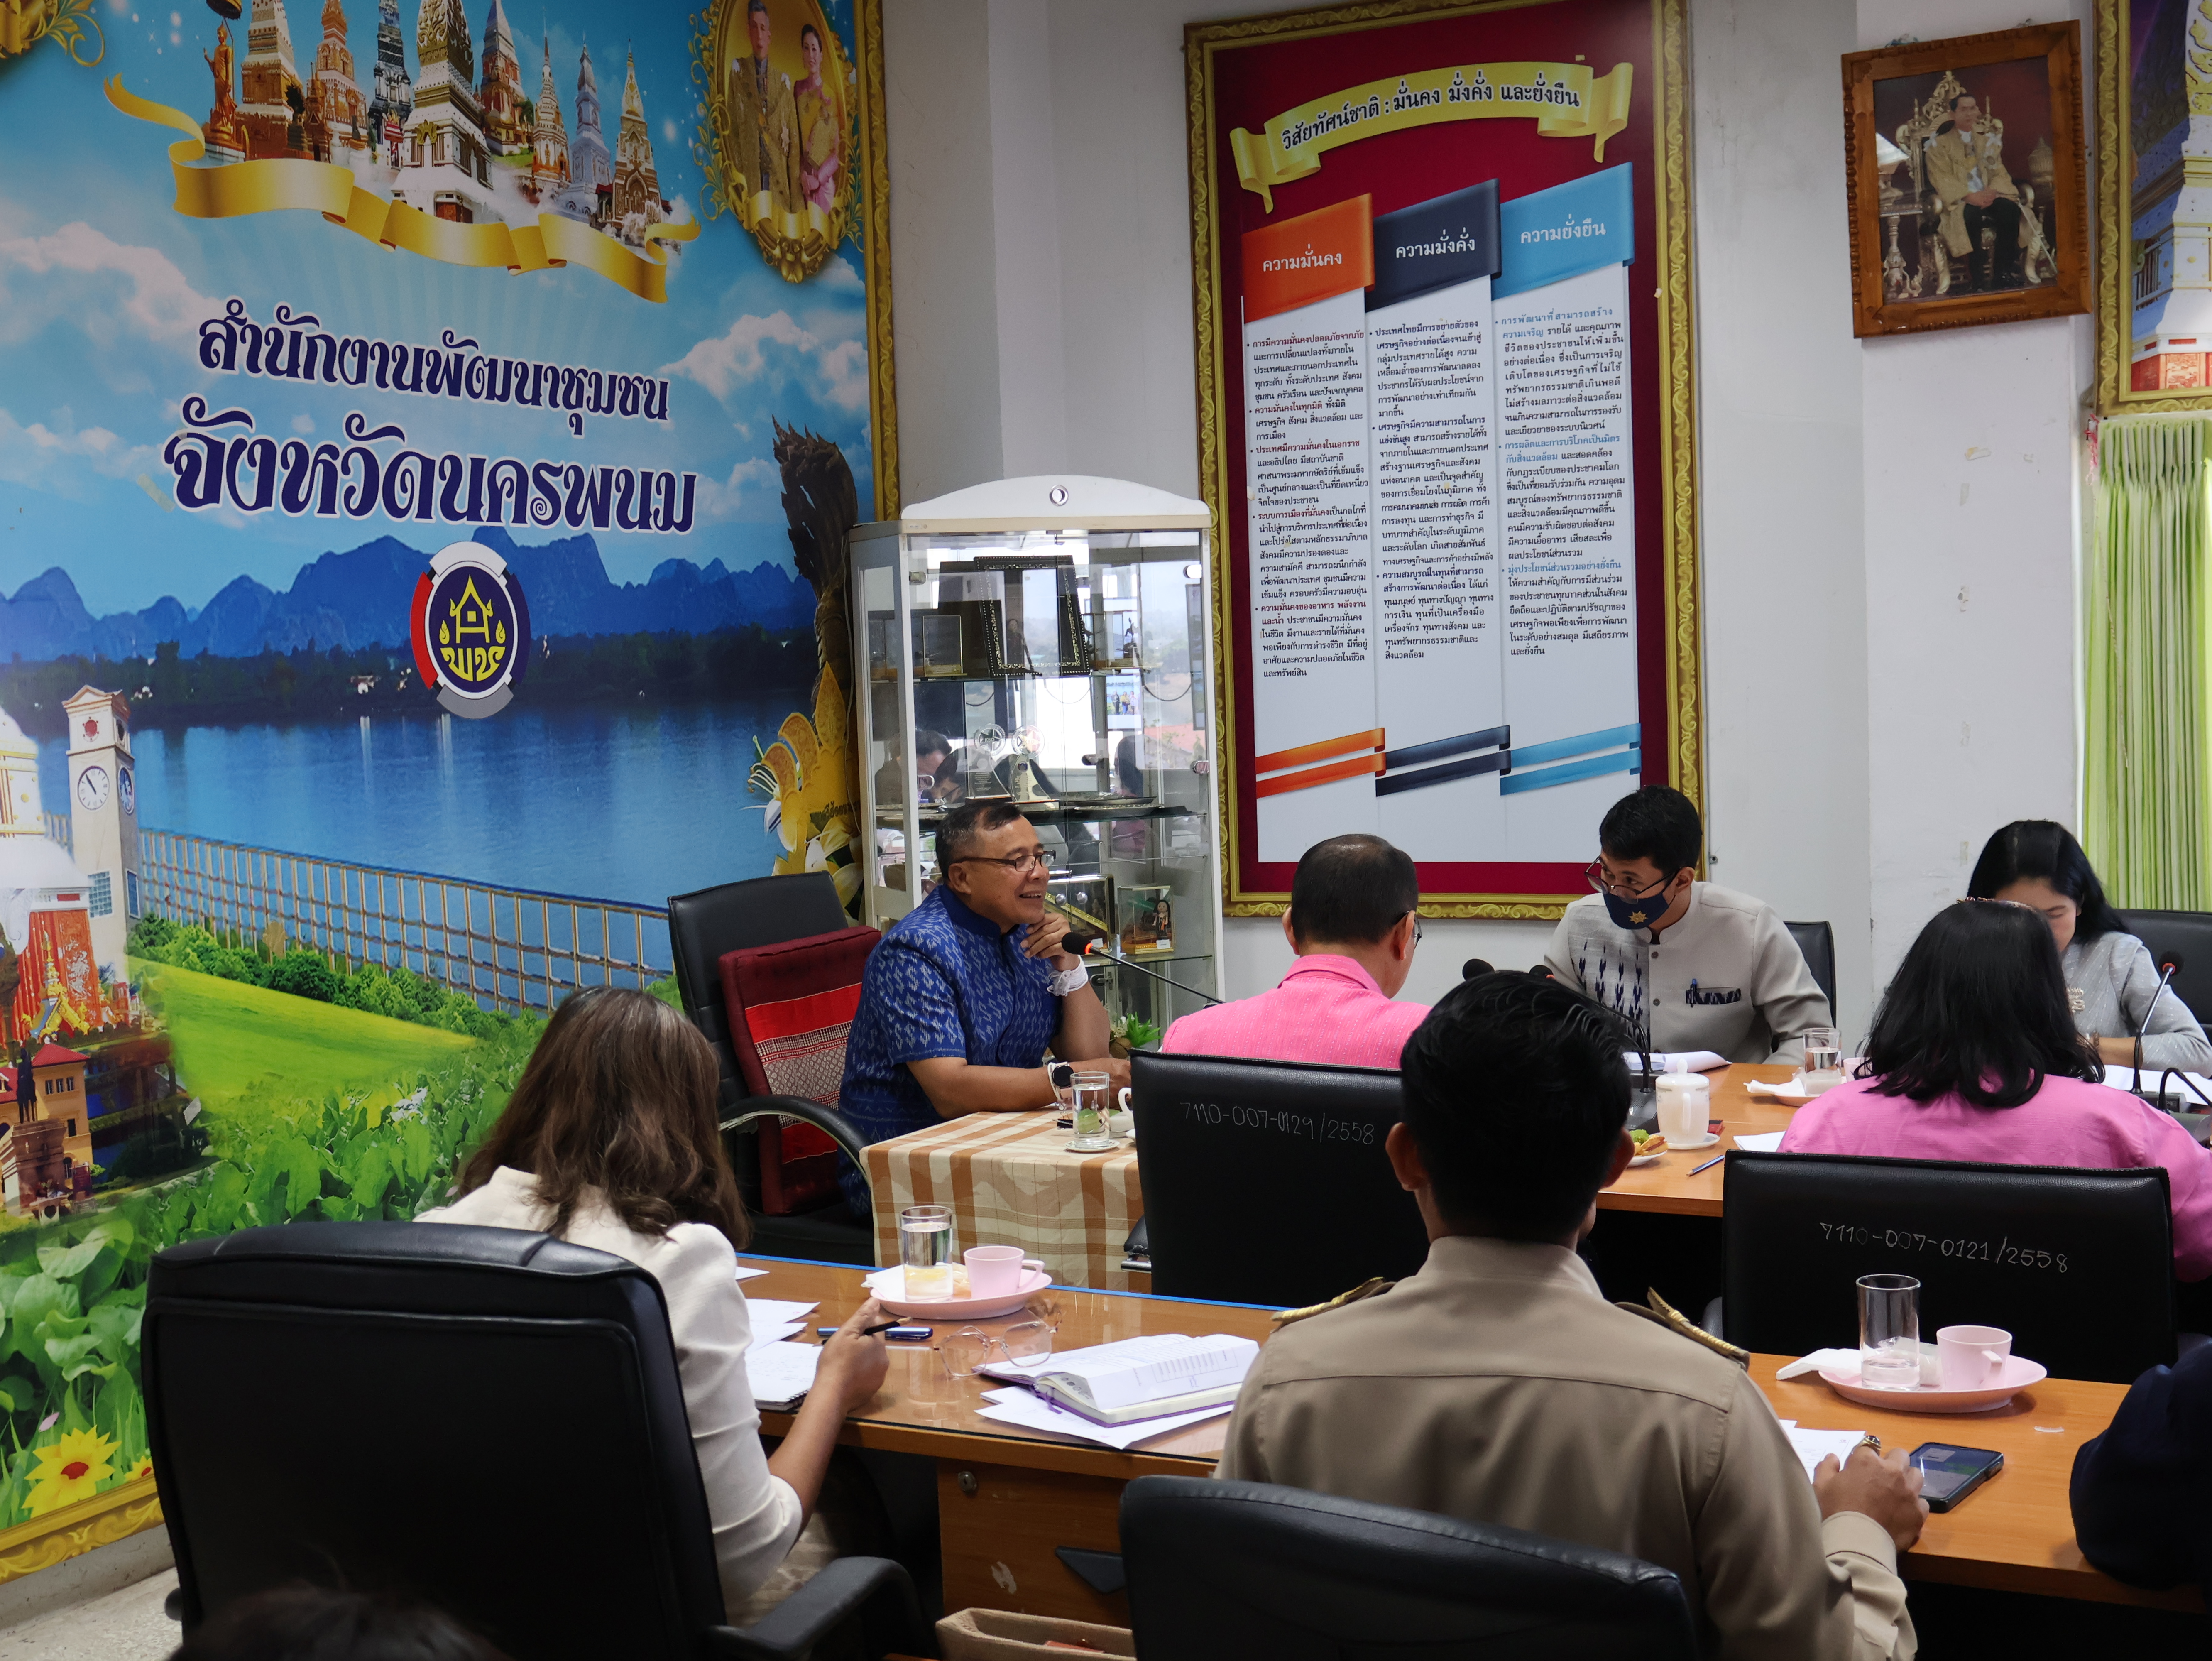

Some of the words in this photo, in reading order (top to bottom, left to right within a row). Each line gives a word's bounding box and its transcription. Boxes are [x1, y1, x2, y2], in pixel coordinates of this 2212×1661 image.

[1282, 98, 1379, 151] วิสัยทัศน์ชาติ
[1394, 80, 1439, 112] มั่นคง
[1449, 71, 1493, 105] มั่งคั่ง
[1501, 72, 1579, 108] และยั่งยืน
[1520, 215, 1605, 243] ความยั่งยืน
[1396, 227, 1475, 258] ความมั่งคั่ง
[1262, 243, 1342, 272] ความมั่นคง
[1503, 328, 1543, 338] ความเจริญ
[1548, 323, 1571, 335] รายได้
[1575, 322, 1621, 333] และคุณภาพ
[1504, 351, 1554, 366] อย่างต่อเนื่อง
[1559, 349, 1622, 361] ซึ่งเป็นการเจริญ
[1255, 378, 1282, 390] ทุกระดับ
[1286, 373, 1338, 385] ทั้งระดับประเทศ
[1343, 372, 1362, 380] สังคม
[1255, 392, 1274, 403] ชุมชน
[1277, 389, 1307, 399] ครัวเรือน
[1310, 386, 1363, 397] และปัจเจกบุคคล
[1325, 397, 1345, 409] ทั้งมิติ
[1379, 404, 1403, 417] มากขึ้น
[1256, 417, 1285, 428] เศรษฐกิจ
[1310, 412, 1346, 422] สิ่งแวดล้อม
[1257, 430, 1285, 440] การเมือง
[1380, 434, 1410, 445] แข่งขันสูง
[1258, 456, 1297, 466] และอธิปไตย
[1301, 453, 1343, 463] มีสถาบันชาติ
[1506, 451, 1557, 463] กับสิ่งแวดล้อม
[1561, 448, 1612, 460] และสอดคล้อง
[164, 397, 695, 533] จังหวัดนครพนม
[1381, 475, 1420, 485] แห่งอนาคต
[1424, 471, 1483, 483] และเป็นจุดสำคัญ
[1589, 478, 1625, 488] ความอุดม
[1476, 483, 1486, 492] ทั้ง
[1258, 497, 1319, 506] จิตใจของประชาชน
[1382, 500, 1439, 512] การคมนาคมขนส่ง
[1441, 499, 1467, 508] การผลิต
[1470, 497, 1489, 506] การค้า
[1382, 517, 1416, 526] การลงทุน
[1419, 512, 1474, 524] และการทำธุรกิจ
[1478, 510, 1483, 519] มี
[1508, 532, 1566, 546] มีความเอื้ออาทร
[1571, 529, 1612, 542] เสียสละเพื่อ
[1383, 541, 1427, 551] และระดับโลก
[1431, 538, 1485, 549] เกิดสายสัมพันธ์
[1509, 549, 1582, 559] ผลประโยชน์ส่วนรวม
[1261, 562, 1302, 572] ความสามัคคี
[1306, 559, 1366, 570] สามารถผนึกกำลัง
[1261, 574, 1320, 586] เพื่อพัฒนาประเทศ
[1324, 574, 1365, 585] ชุมชนมีความ
[1468, 578, 1488, 588] ได้แก่
[1261, 588, 1286, 598] เข้มแข็ง
[1338, 600, 1366, 608] พลังงาน
[1384, 596, 1415, 608] ทุนมนุษย์
[1418, 594, 1466, 607] ทุนทางปัญญา
[1469, 595, 1493, 604] ทุนทาง
[1262, 613, 1284, 625] และน้ำ
[1385, 610, 1412, 619] การเงิน
[1262, 629, 1283, 638] ในชีวิต
[1385, 620, 1419, 632] เครื่องจักร
[1423, 621, 1468, 634] ทุนทางสังคม
[1510, 631, 1578, 642] ในระดับอย่างสมดุล
[1583, 630, 1628, 639] มีเสถียรภาพ
[1347, 637, 1367, 650] มีที่อยู่
[1511, 643, 1545, 655] และยั่งยืน
[1264, 668, 1307, 677] และทรัพย์สิน
[1820, 1222, 2068, 1273] 7110-007-0121/2558
